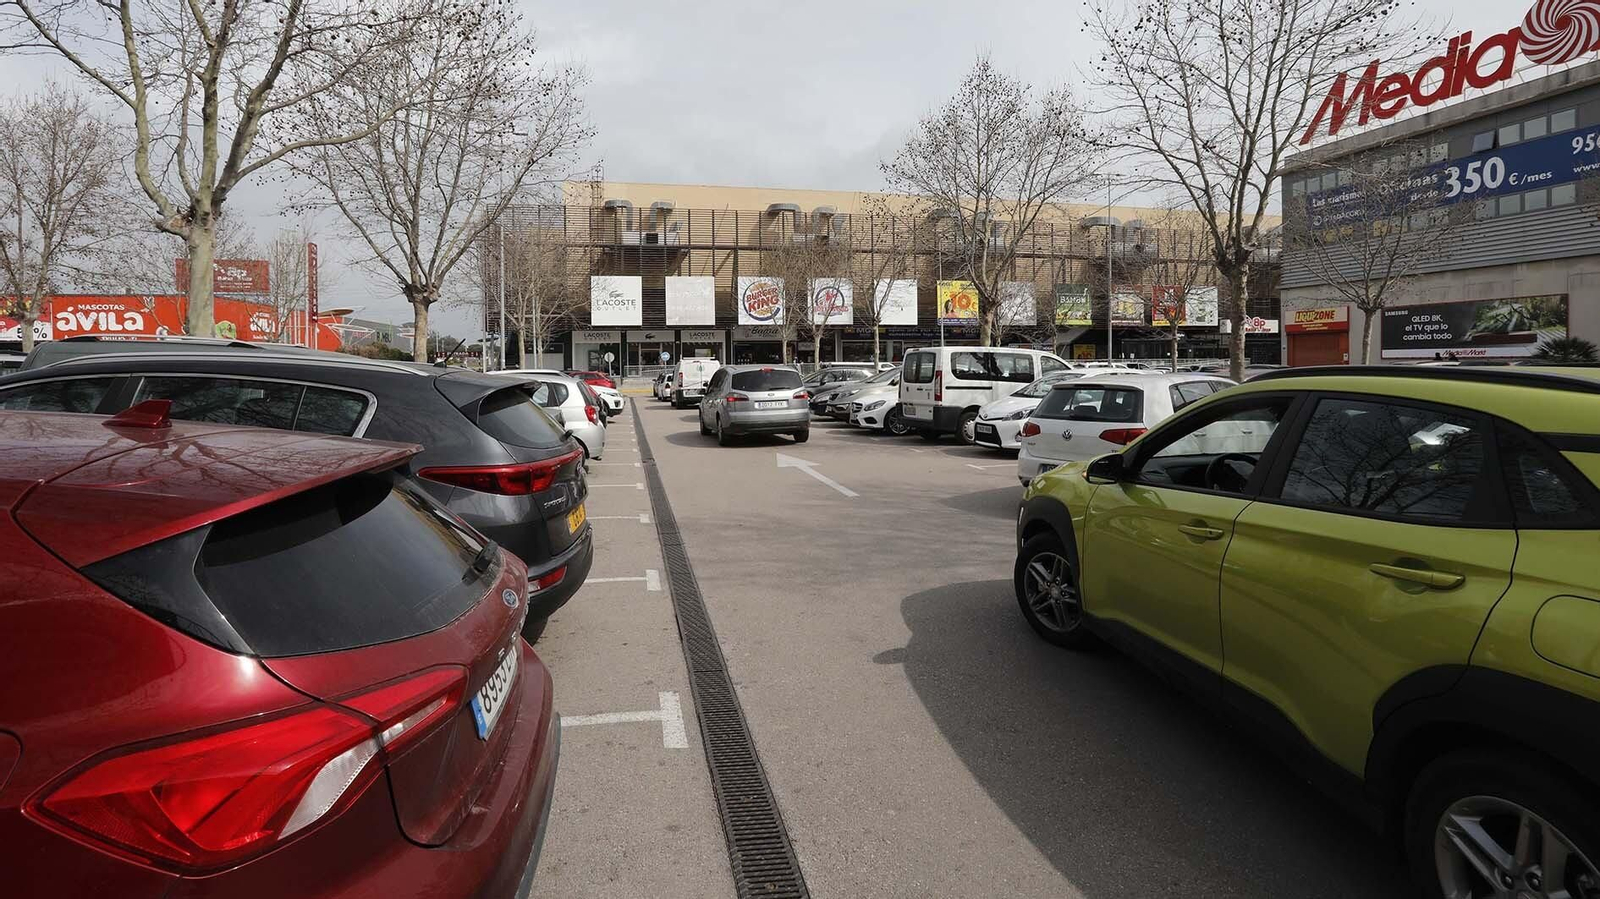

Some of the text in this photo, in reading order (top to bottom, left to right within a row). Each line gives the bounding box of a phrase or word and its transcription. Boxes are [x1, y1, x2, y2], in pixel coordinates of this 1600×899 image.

[1299, 26, 1522, 147] Media
[1444, 156, 1506, 198] 350
[1508, 172, 1519, 186] €
[746, 287, 778, 302] BURGER
[596, 299, 637, 307] LACOSTE
[747, 294, 779, 313] KING
[1295, 310, 1336, 323] LIQUIZONE
[1424, 324, 1439, 332] que
[1403, 333, 1432, 341] cambia
